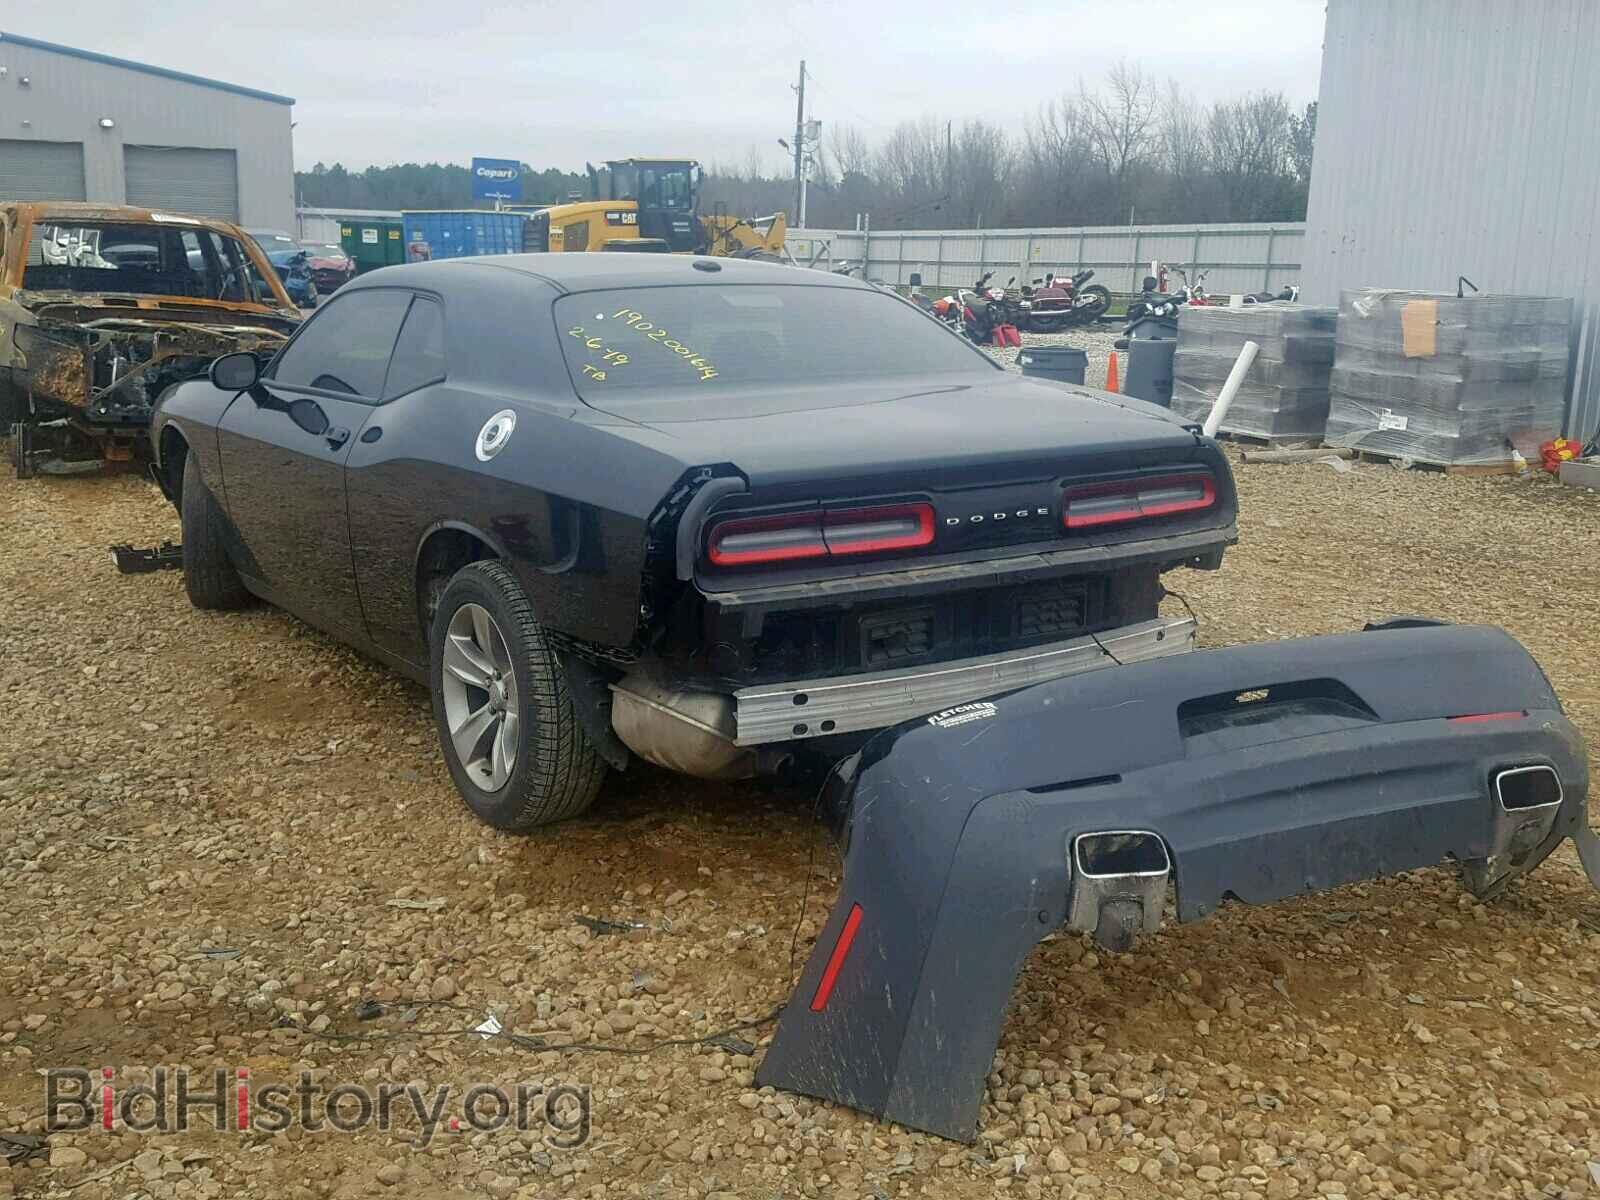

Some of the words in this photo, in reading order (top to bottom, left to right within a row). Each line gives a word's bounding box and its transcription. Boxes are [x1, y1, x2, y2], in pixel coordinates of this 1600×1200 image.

[476, 167, 513, 179] Copart
[622, 212, 637, 224] CAT
[946, 508, 1049, 525] DODGE
[927, 702, 999, 726] FLETCHER
